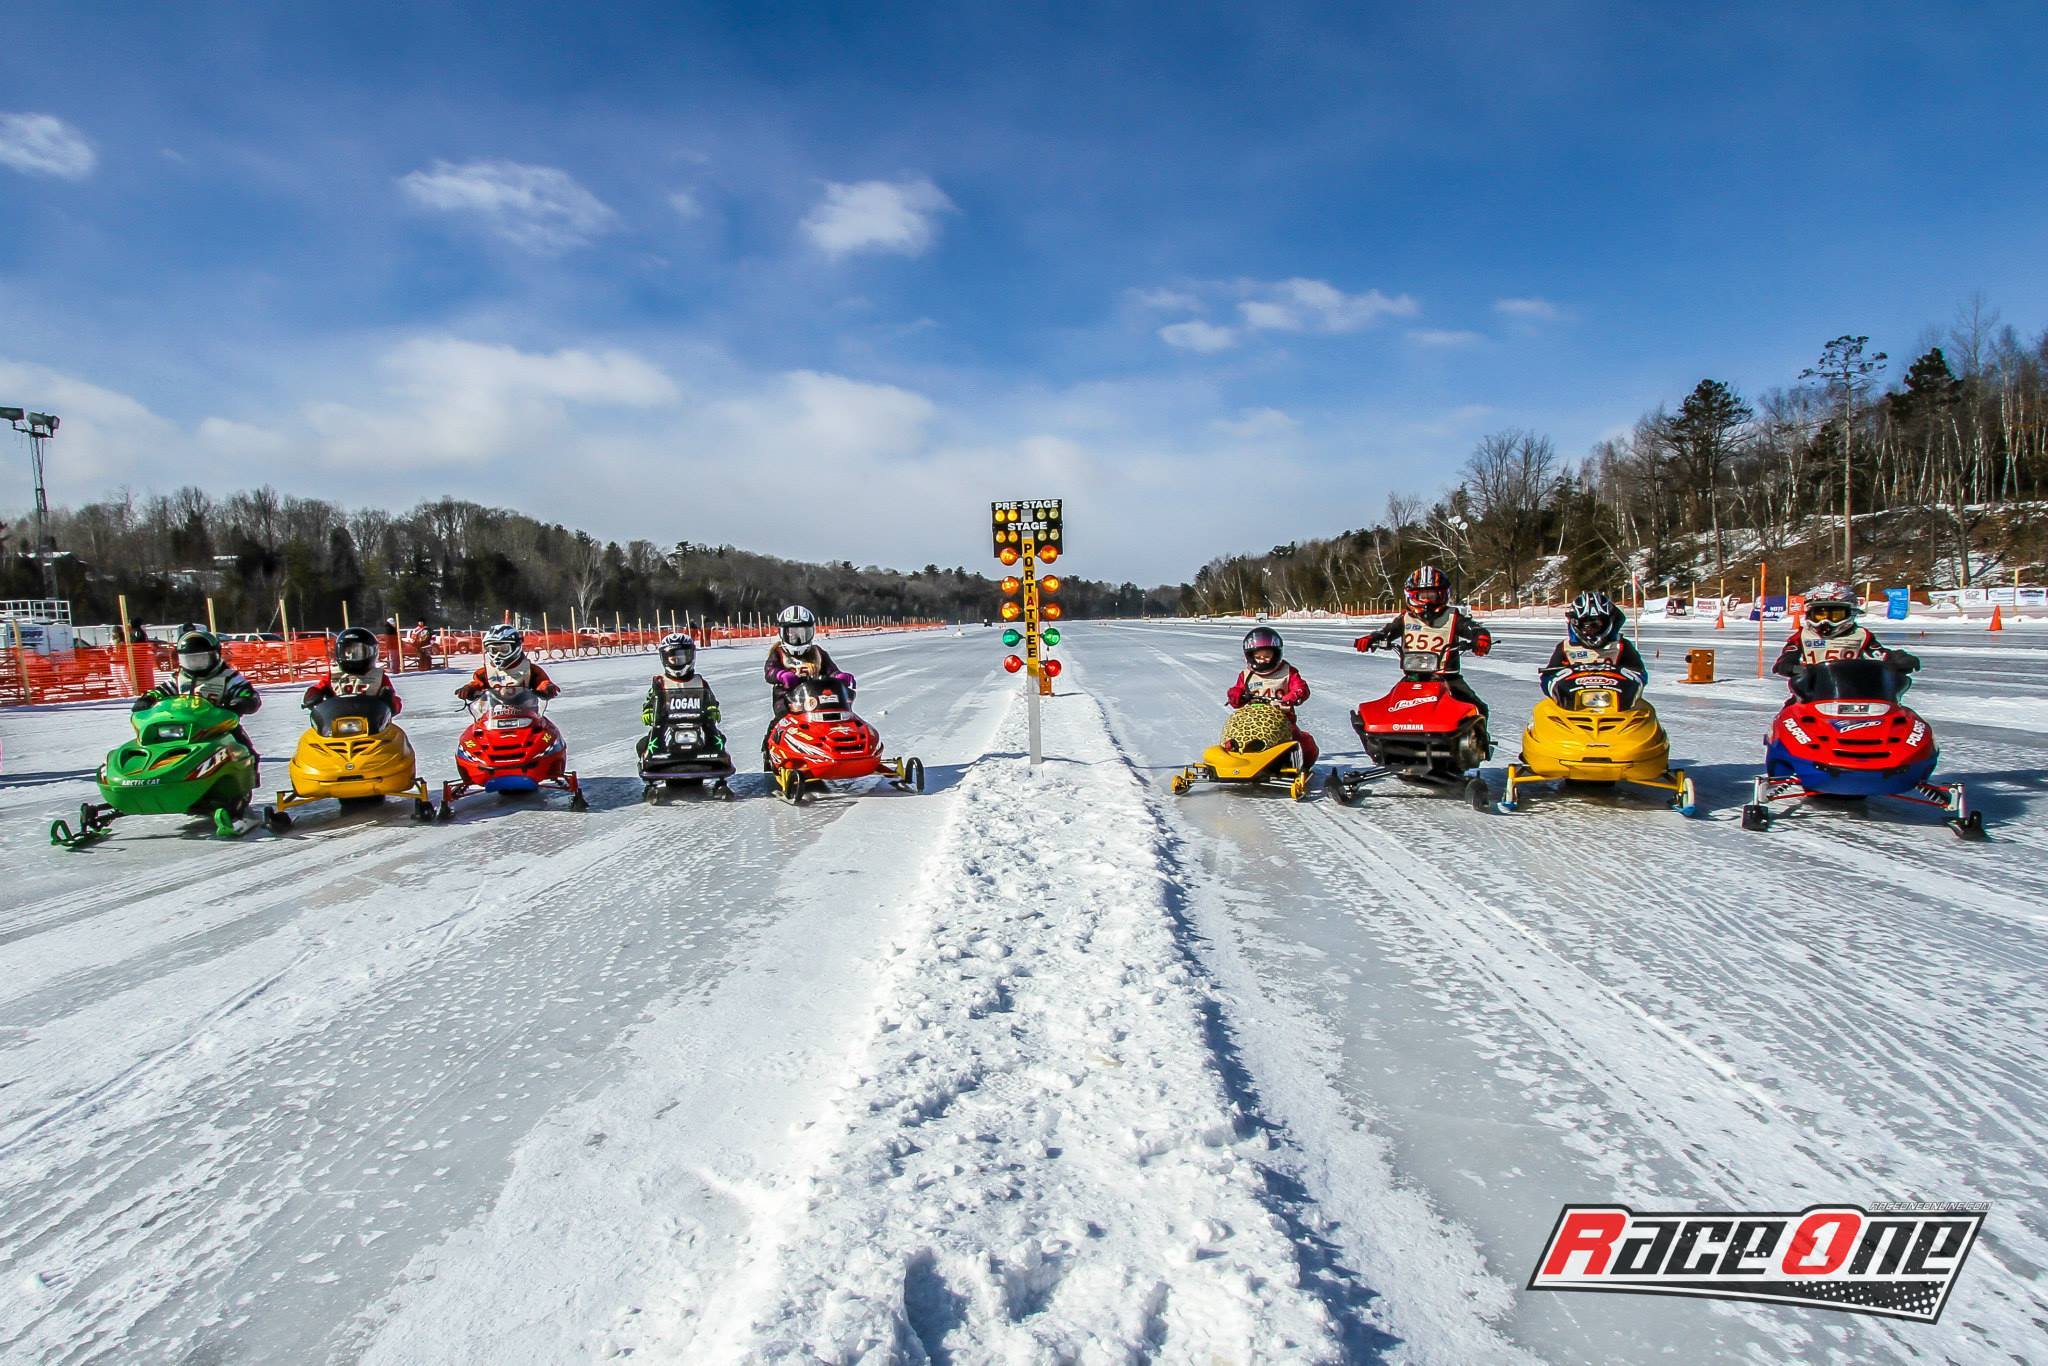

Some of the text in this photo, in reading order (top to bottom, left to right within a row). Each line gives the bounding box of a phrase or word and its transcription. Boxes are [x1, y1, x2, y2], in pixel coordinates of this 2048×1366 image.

[995, 500, 1059, 511] PRE-STAGE
[1008, 522, 1048, 531] STAGE
[1024, 543, 1037, 658] PORTATREE
[1405, 633, 1444, 652] 252
[670, 698, 701, 710] LOGAN
[1783, 717, 1812, 745] POLARIS
[1906, 720, 1926, 746] POLARIS
